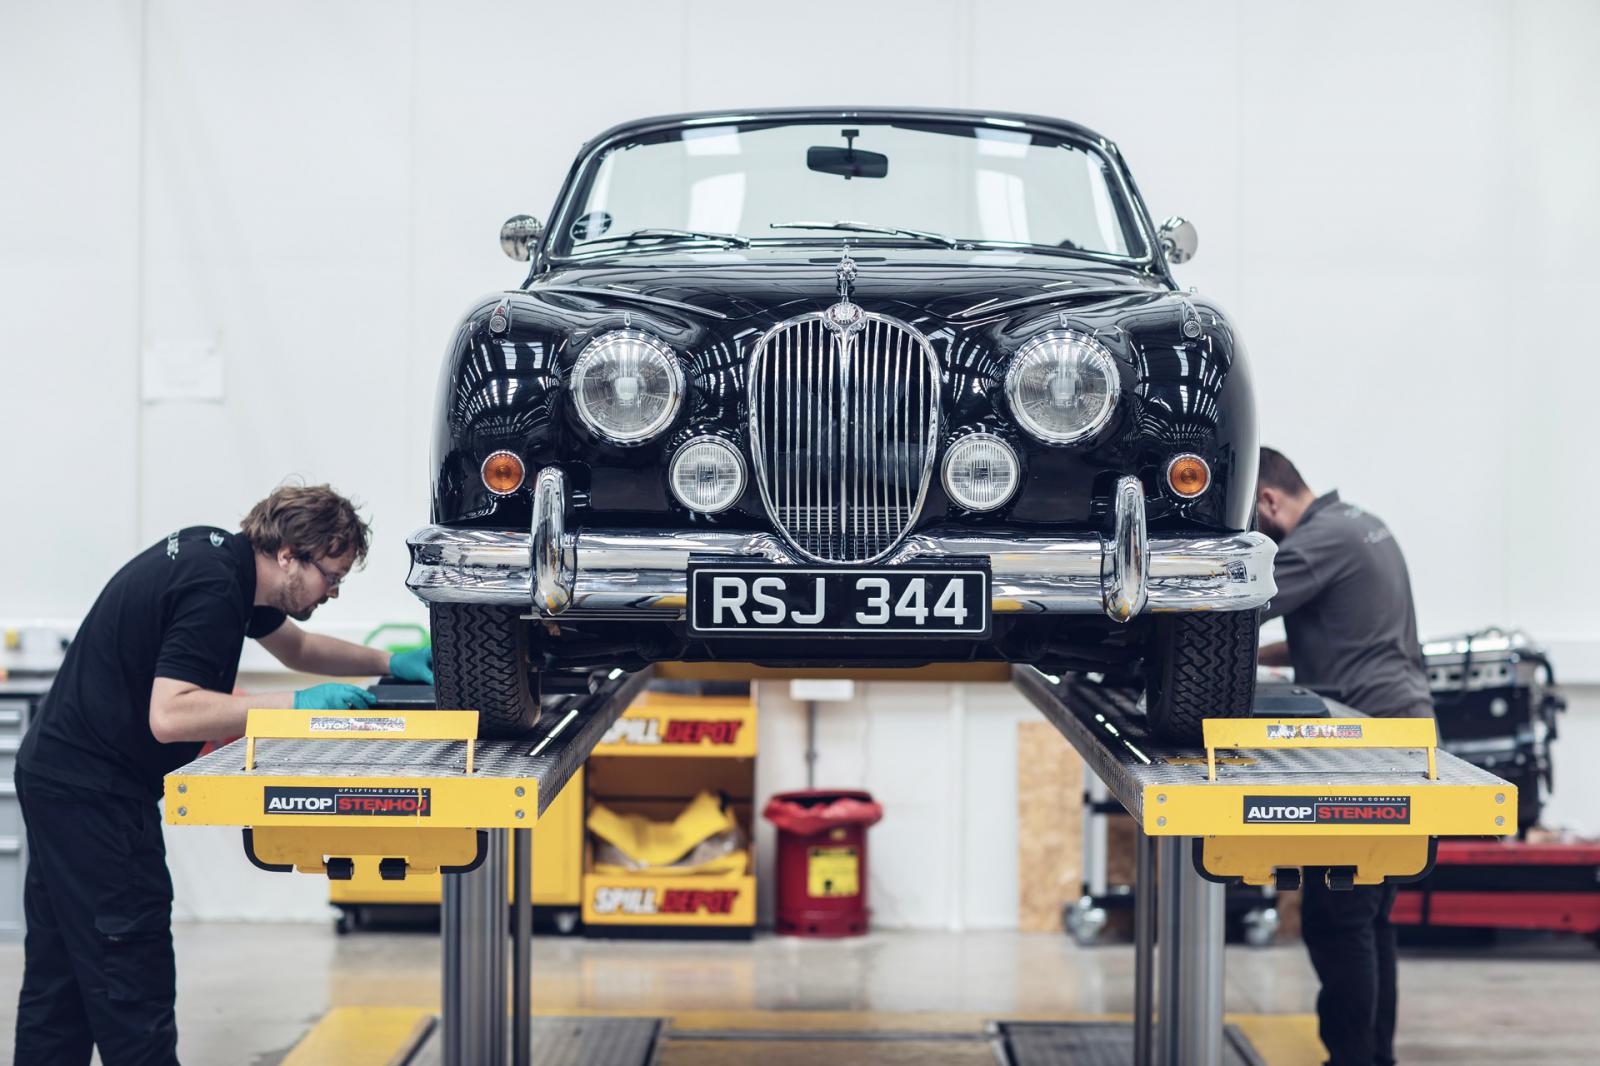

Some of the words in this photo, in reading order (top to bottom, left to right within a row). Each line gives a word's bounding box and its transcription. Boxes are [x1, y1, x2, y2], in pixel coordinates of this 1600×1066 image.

[713, 577, 826, 624] RSJ
[856, 578, 968, 625] 344
[663, 719, 743, 744] DEPOT
[268, 797, 333, 810] AUTOP
[338, 797, 427, 812] STENHOJ
[1248, 806, 1312, 819] AUTOP
[1318, 806, 1408, 819] STENHOJ
[594, 887, 658, 914] SPILL
[661, 888, 740, 914] DEPOT
